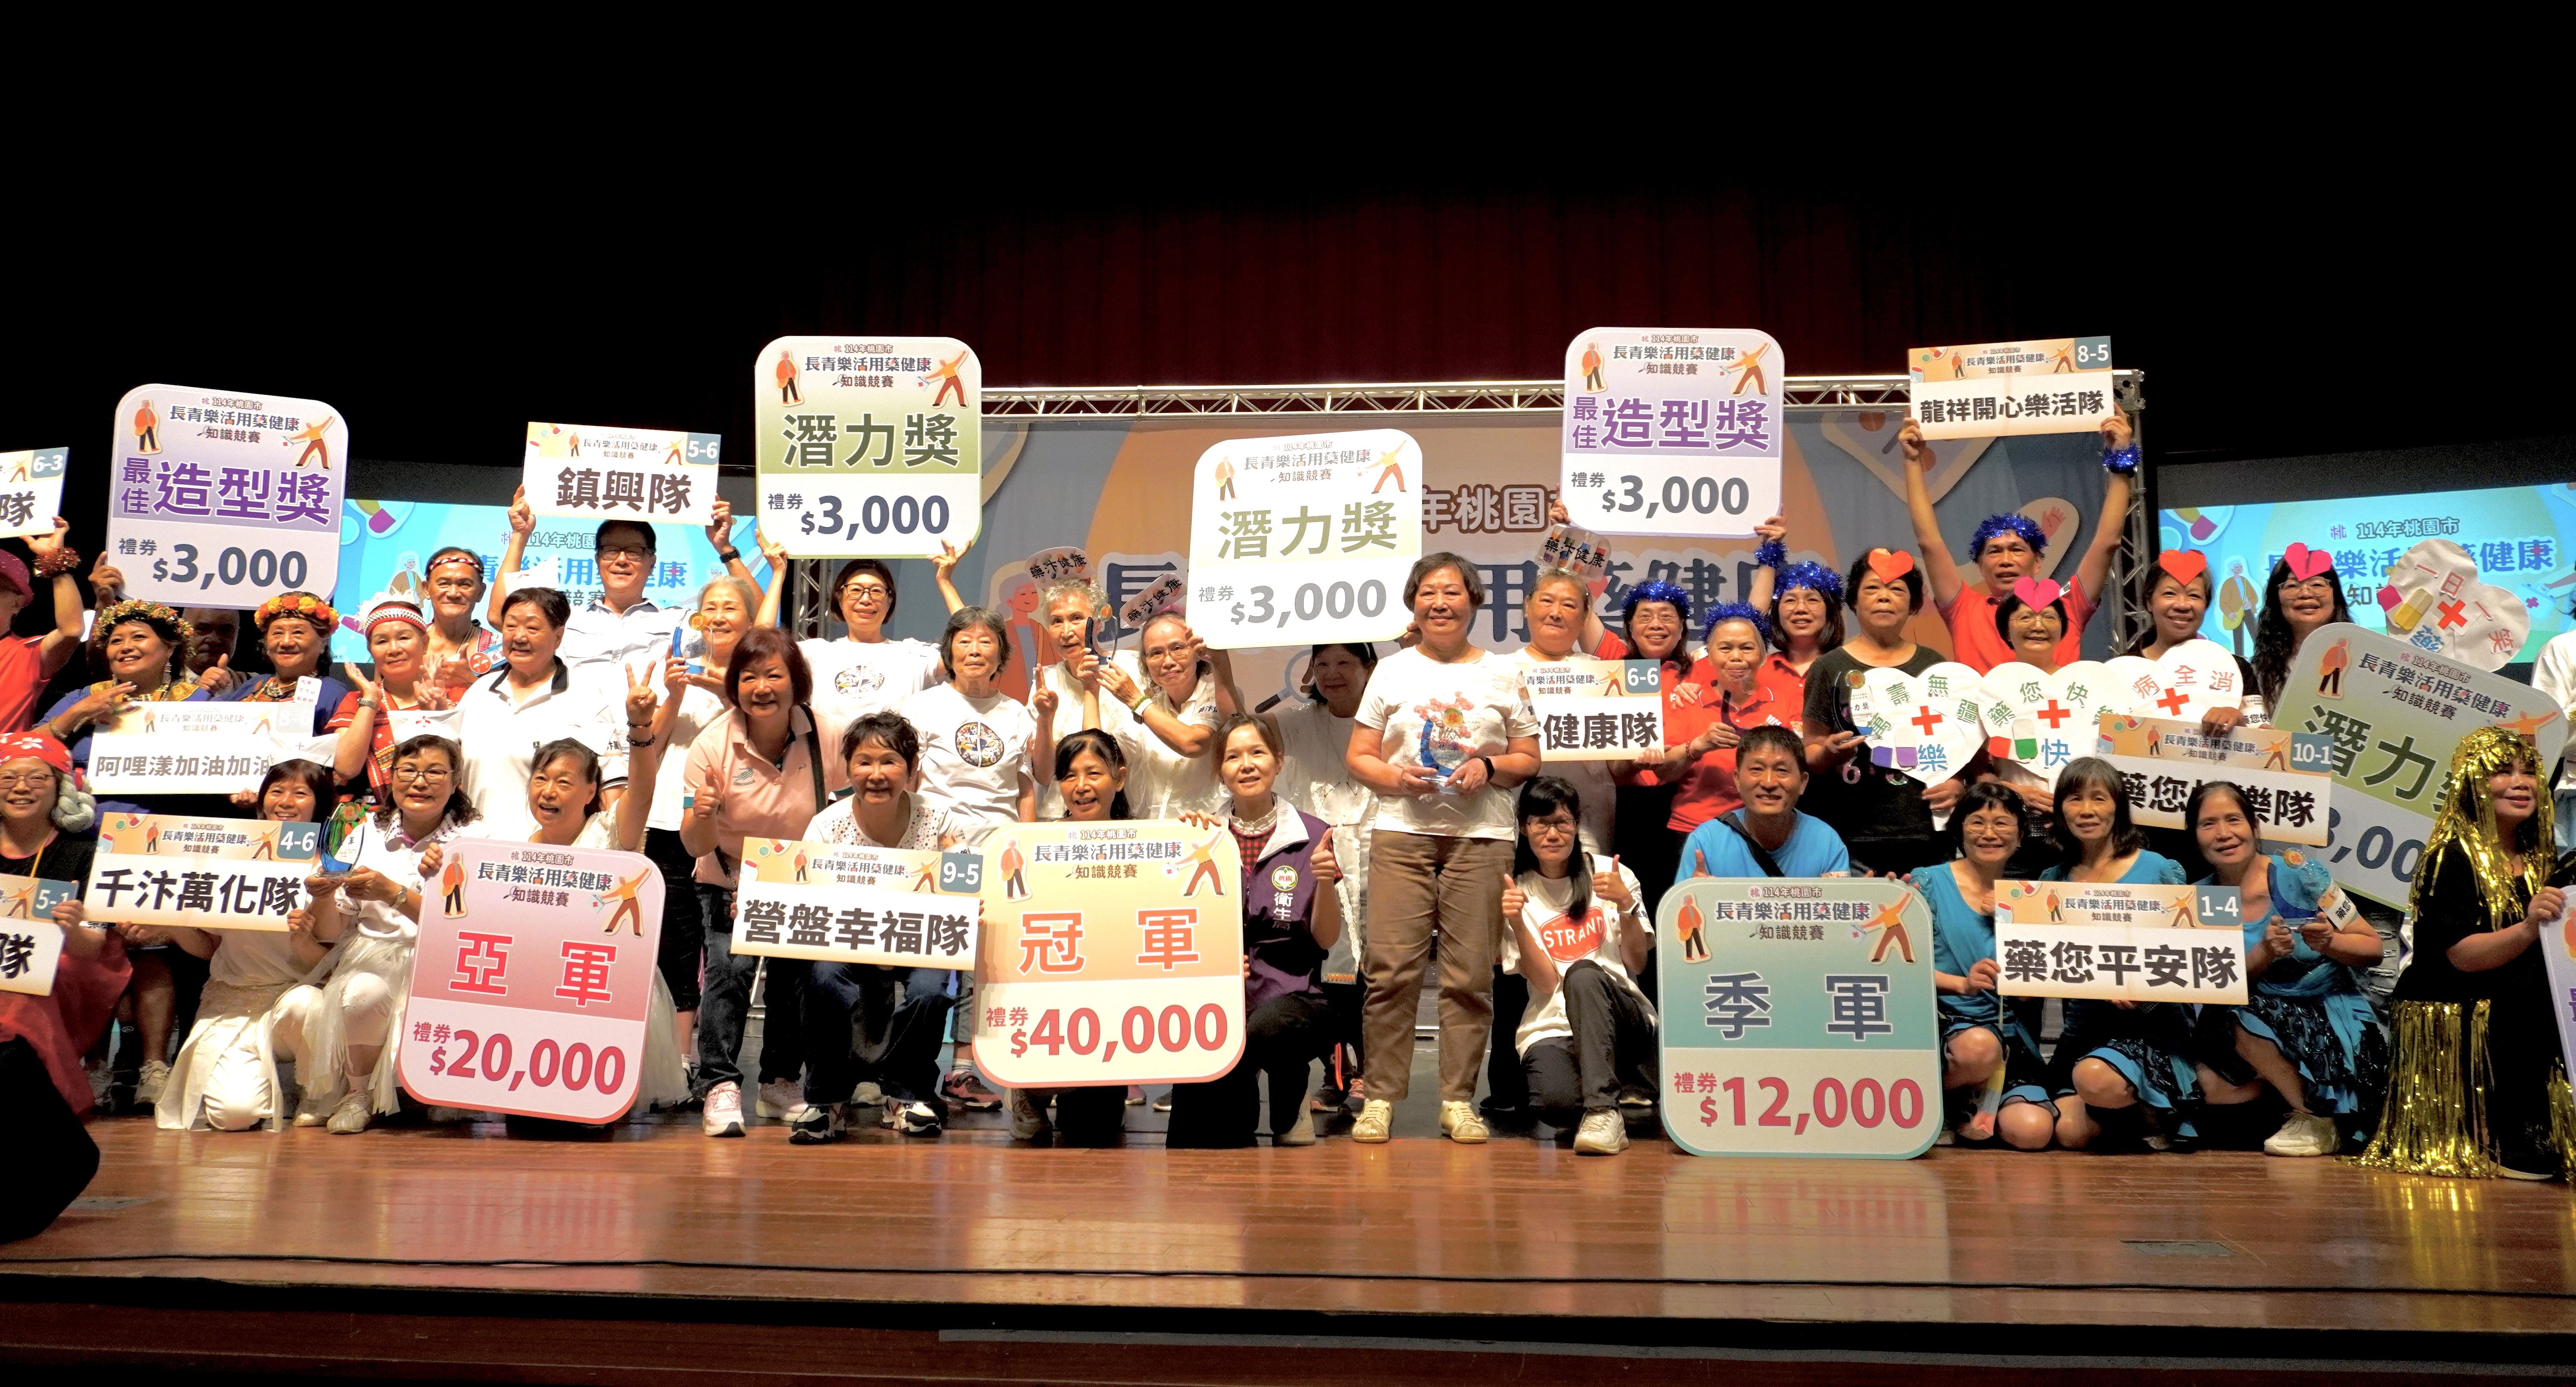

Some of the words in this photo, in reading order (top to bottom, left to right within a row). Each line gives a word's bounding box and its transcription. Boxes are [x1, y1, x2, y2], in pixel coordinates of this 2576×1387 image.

[844, 344, 893, 354] 114年桃園市
[1652, 335, 1699, 344] 114年桃園市
[805, 356, 932, 372] 長青樂活用藥健康
[1613, 345, 1736, 361] 長青樂活用藥健康
[1966, 353, 2046, 366] 長青樂活用藥健康
[2077, 344, 2109, 363] 8-5
[1646, 363, 1698, 375] 知識競賽
[1988, 365, 2022, 374] 知識競賽
[840, 375, 894, 388] 知識競賽
[212, 397, 263, 411] 114年桃園市
[1920, 391, 2105, 424] 龍祥開心樂活隊
[169, 405, 300, 432] 長青樂活用藥健康
[1572, 396, 1599, 450] 最佳
[1601, 397, 1770, 451] 造型獎
[205, 426, 261, 444] 知識競賽
[782, 413, 958, 468] 潛力獎
[688, 441, 718, 459] 5-6
[1244, 449, 1371, 470] 長青樂活用藥健康
[33, 454, 64, 472] 6-3
[121, 457, 152, 515] 最佳
[1279, 468, 1332, 483] 知識競賽
[154, 462, 331, 526] 造型獎
[556, 466, 692, 514] 鎮興隊
[1571, 471, 1606, 488] 禮券
[1602, 474, 1750, 519] $3,000
[0, 491, 36, 527] 隊
[768, 493, 803, 510] 禮券
[801, 495, 950, 541] $3,000
[1217, 500, 1397, 560] 潛力獎
[2357, 517, 2460, 539] 114年桃園市
[118, 538, 158, 556] 禮券
[152, 543, 307, 591] $3,000
[1198, 585, 1234, 603] 禮券
[1230, 578, 1387, 629] $3,000
[1627, 667, 1659, 686] 6-6
[2412, 655, 2472, 684] 114年桃園市
[1538, 686, 1571, 695] 知識競賽
[2358, 653, 2511, 718] 長青樂活用藥健康
[2392, 687, 2458, 721] 知識競賽
[1538, 712, 1659, 750] 健康隊
[1917, 743, 1949, 772] 樂
[2188, 750, 2227, 762] 知識競賽
[2292, 742, 2332, 765] 10-1
[2304, 704, 2453, 813] 潛力
[162, 830, 248, 845] 長青樂活用藥健康
[280, 830, 316, 852] 4-6
[1081, 828, 1137, 840] 114年桃園市
[183, 844, 219, 855] 知識競賽
[522, 851, 574, 866] 114年桃園市
[1034, 842, 1182, 862] 長青樂活用藥健康
[477, 862, 613, 891] 長青樂活用藥健康
[812, 858, 906, 876] 長青樂活用藥健康
[943, 861, 979, 885] 9-5
[1075, 864, 1138, 879] 知識競賽
[836, 873, 876, 885] 知識競賽
[95, 869, 301, 916] 千汴萬化隊
[511, 887, 570, 908] 知識競賽
[1762, 886, 1822, 898] 114年桃園市
[1716, 901, 1871, 922] 長青樂活用藥健康
[2065, 897, 2161, 912] 長青樂活用藥健康
[2201, 894, 2239, 918] 1-4
[743, 900, 969, 956] 營盤幸福隊
[2091, 912, 2133, 923] 知識競賽
[1543, 916, 1604, 949] STRAND
[1759, 925, 1825, 941] 知識競賽
[0, 933, 36, 979] 隊
[2004, 938, 2239, 989] 藥您平安隊
[413, 1021, 451, 1044] 禮券
[986, 1007, 1029, 1027] 禮券
[1010, 1003, 1228, 1063] $40,000
[430, 1029, 626, 1095] $20,000
[1674, 1072, 1717, 1094] 禮券
[1699, 1076, 1924, 1136] $12,000
